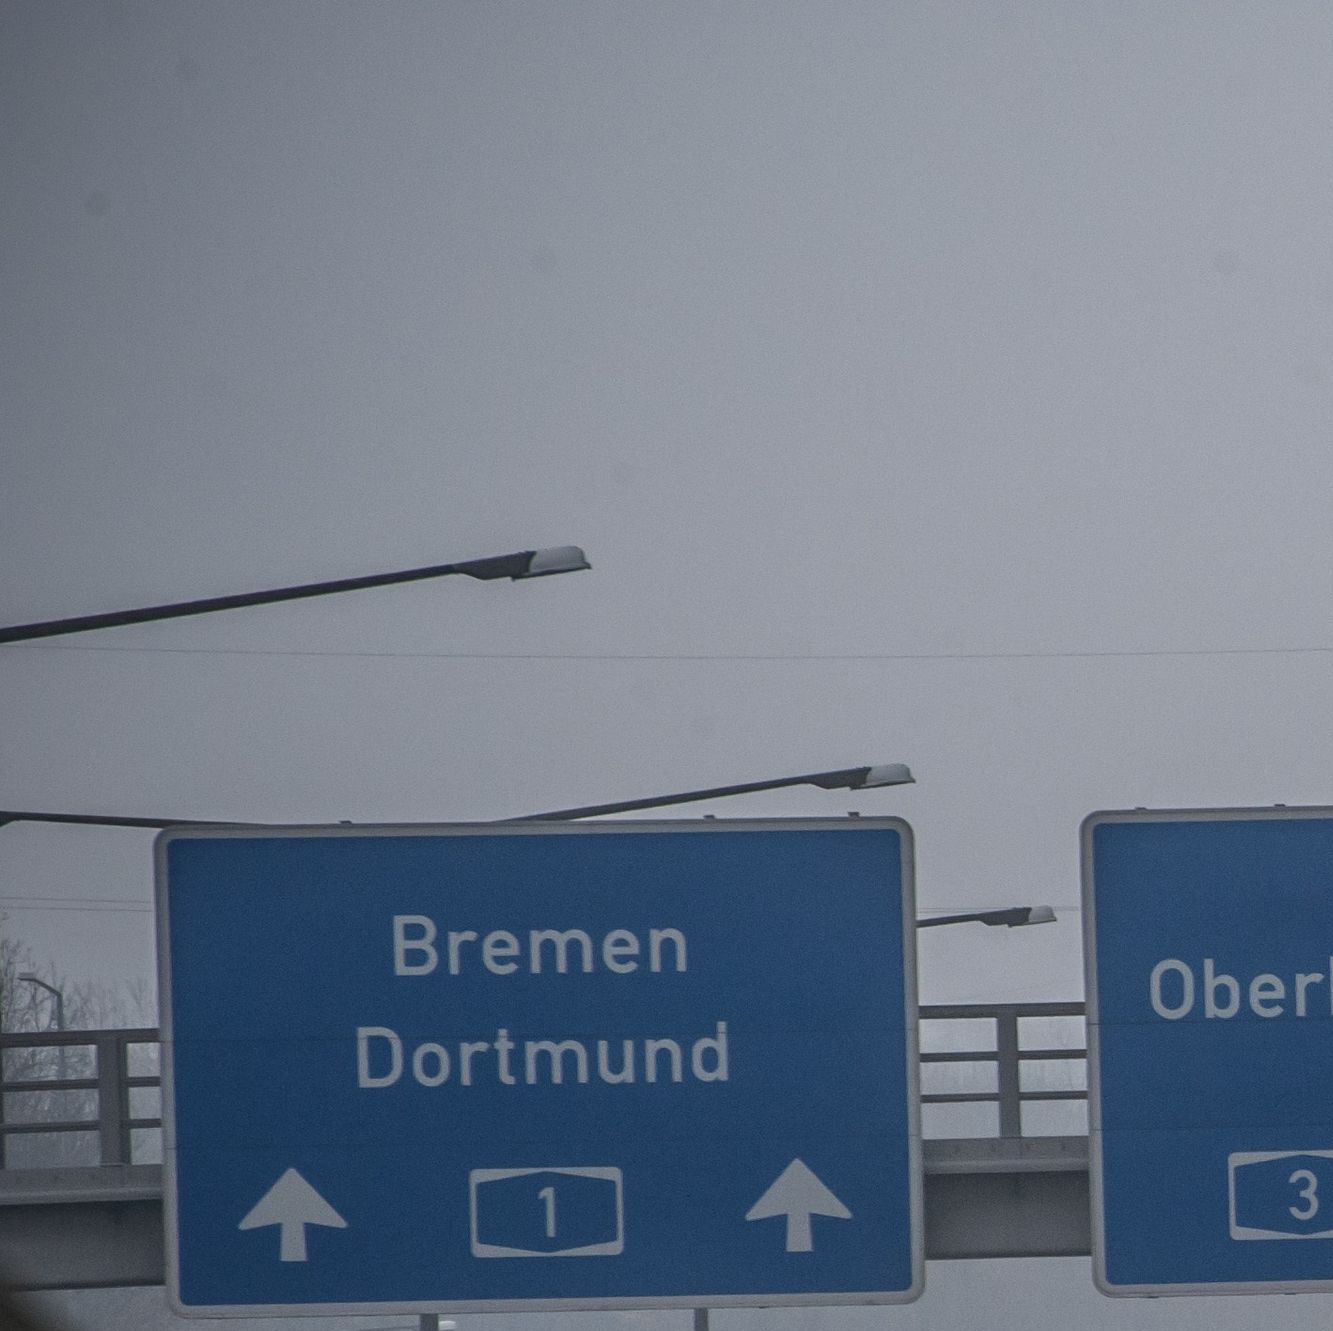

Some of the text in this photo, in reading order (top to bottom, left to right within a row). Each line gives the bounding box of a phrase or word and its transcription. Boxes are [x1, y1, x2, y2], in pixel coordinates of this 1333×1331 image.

[393, 914, 687, 976] Bremen
[357, 1021, 729, 1088] Dortmund
[537, 1186, 557, 1238] 1
[1288, 1169, 1319, 1221] 3
